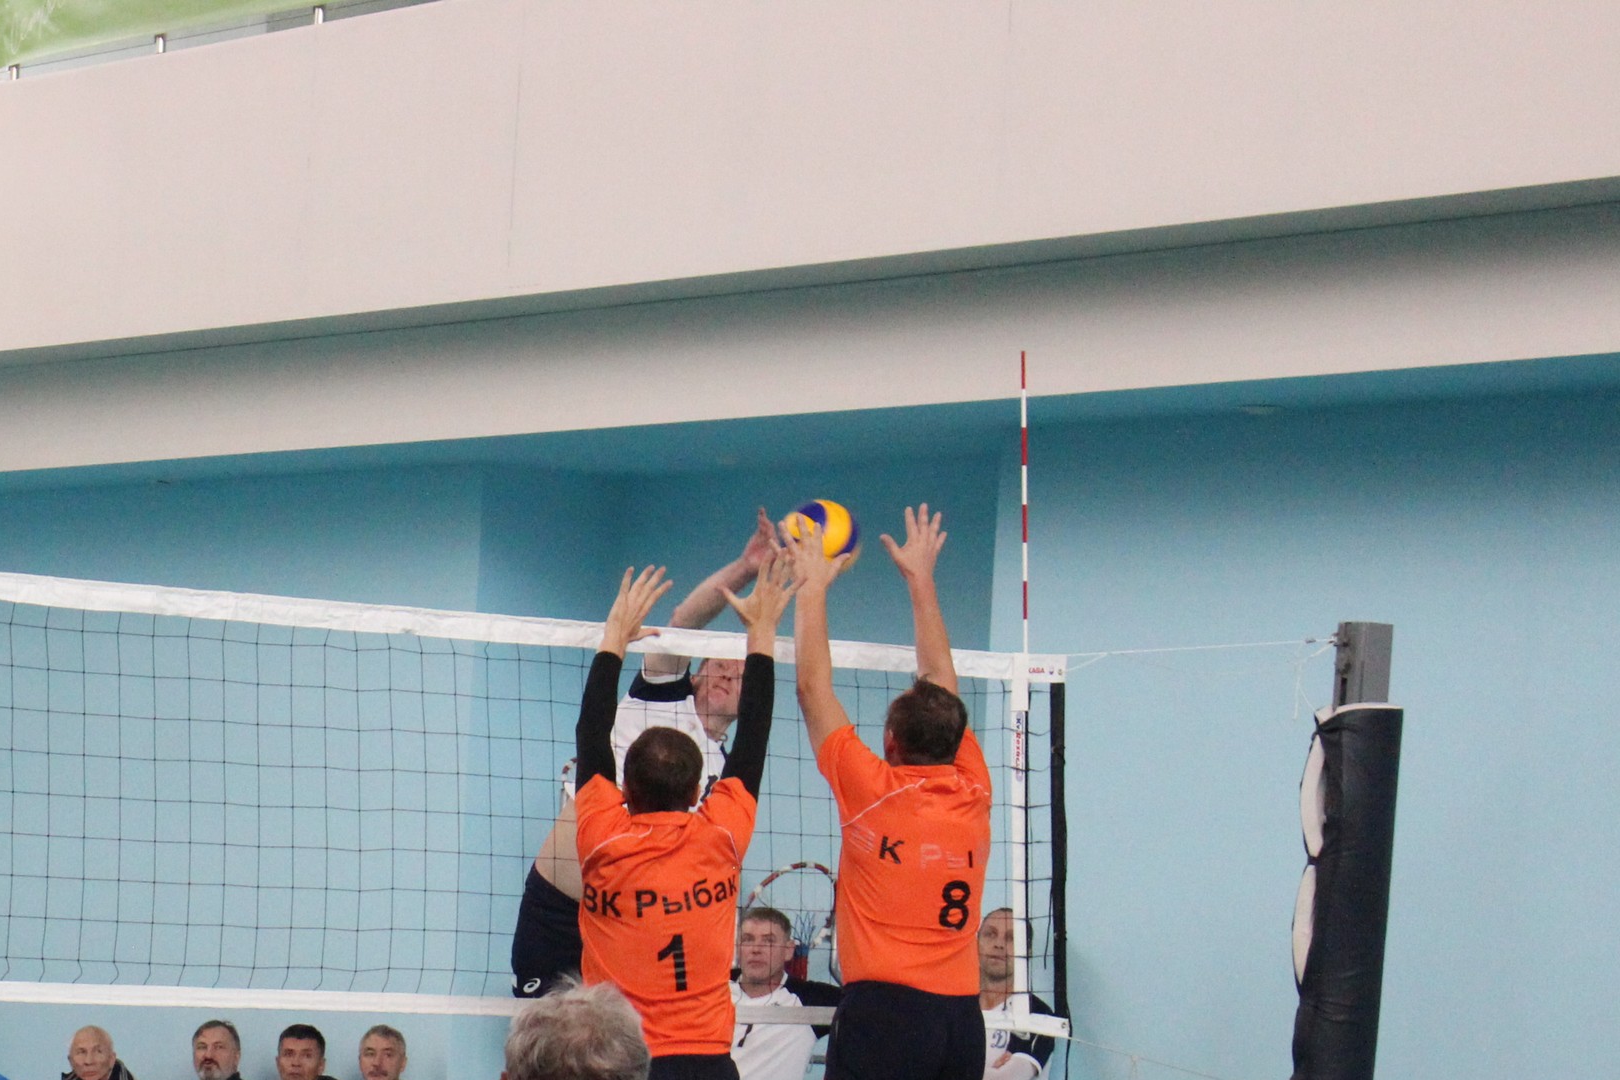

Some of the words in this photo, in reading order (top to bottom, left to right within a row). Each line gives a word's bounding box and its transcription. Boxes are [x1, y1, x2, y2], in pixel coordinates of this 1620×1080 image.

[583, 882, 621, 918] ВК
[635, 875, 737, 918] Рыбак
[938, 880, 971, 931] 8
[657, 934, 688, 992] 1
